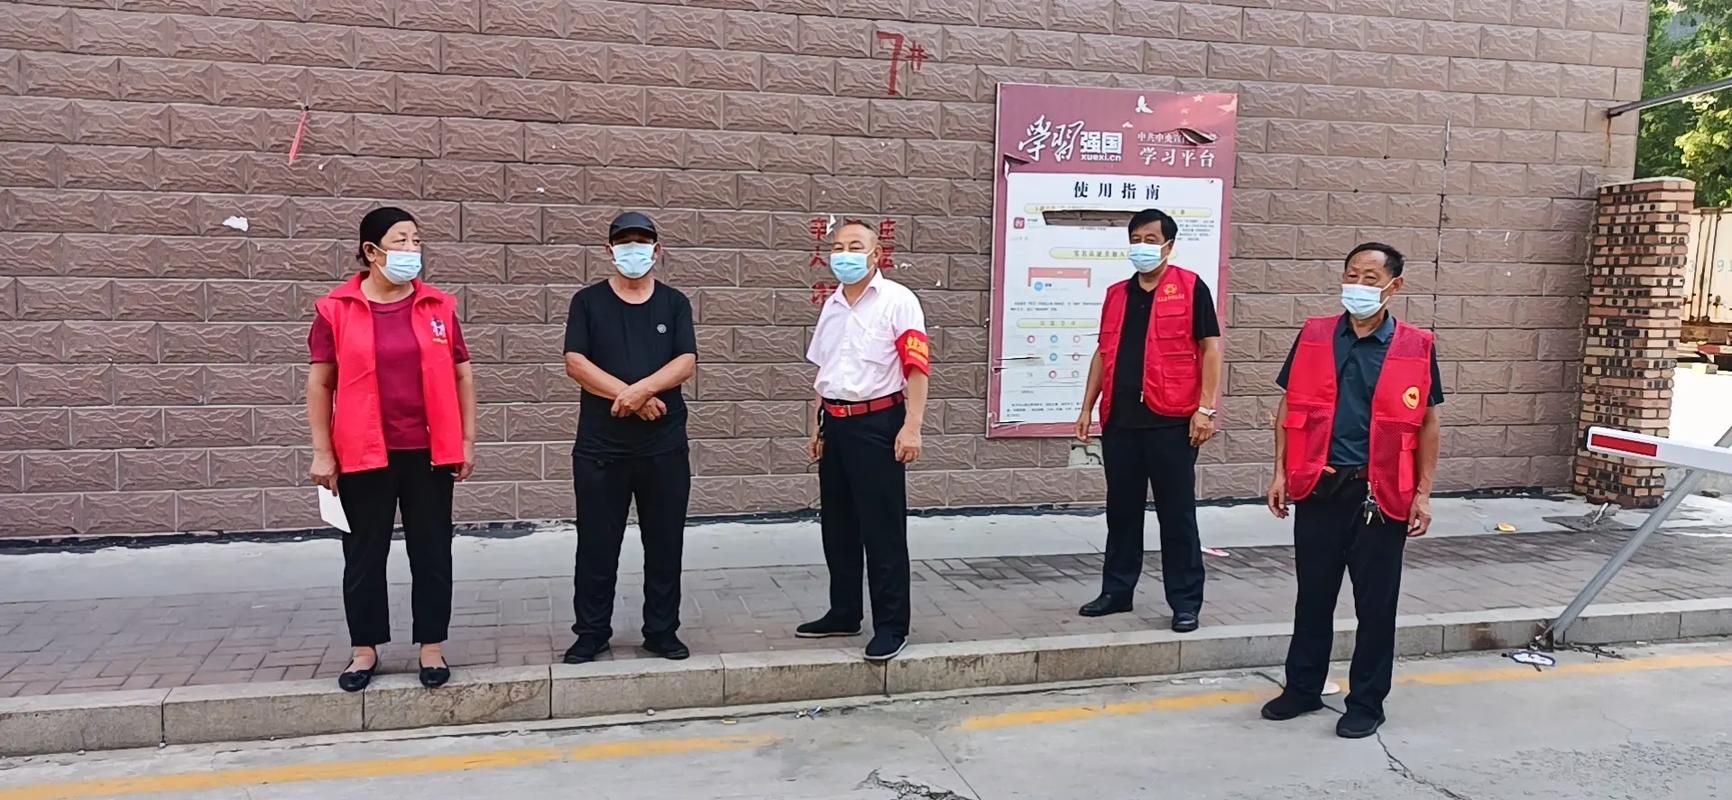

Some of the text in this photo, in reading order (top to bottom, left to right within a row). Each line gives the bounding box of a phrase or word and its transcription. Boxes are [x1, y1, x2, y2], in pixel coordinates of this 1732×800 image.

[1081, 153, 1122, 161] xuexi.cn
[1139, 146, 1215, 168] 学习平台
[1073, 181, 1160, 200] 使用指南
